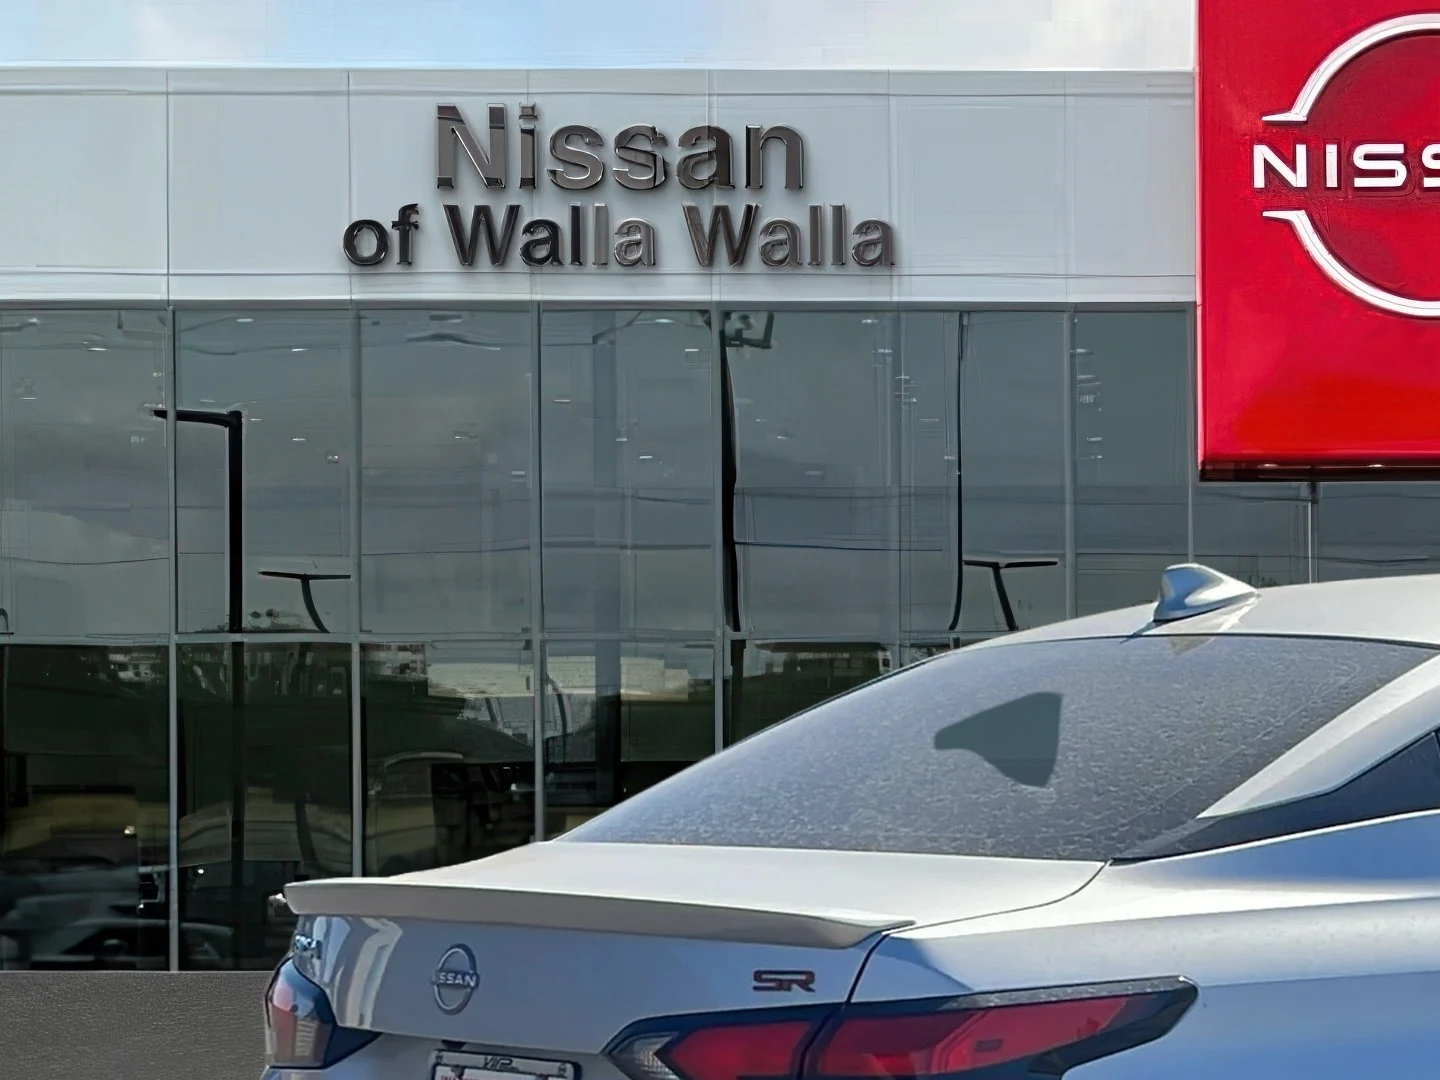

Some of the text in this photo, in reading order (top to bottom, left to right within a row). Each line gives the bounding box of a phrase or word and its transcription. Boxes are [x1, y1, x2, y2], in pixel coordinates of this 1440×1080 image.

[435, 102, 805, 190] Nissan
[341, 202, 896, 268] of Walla Walla
[430, 970, 477, 987] SSAN
[752, 969, 817, 993] SR
